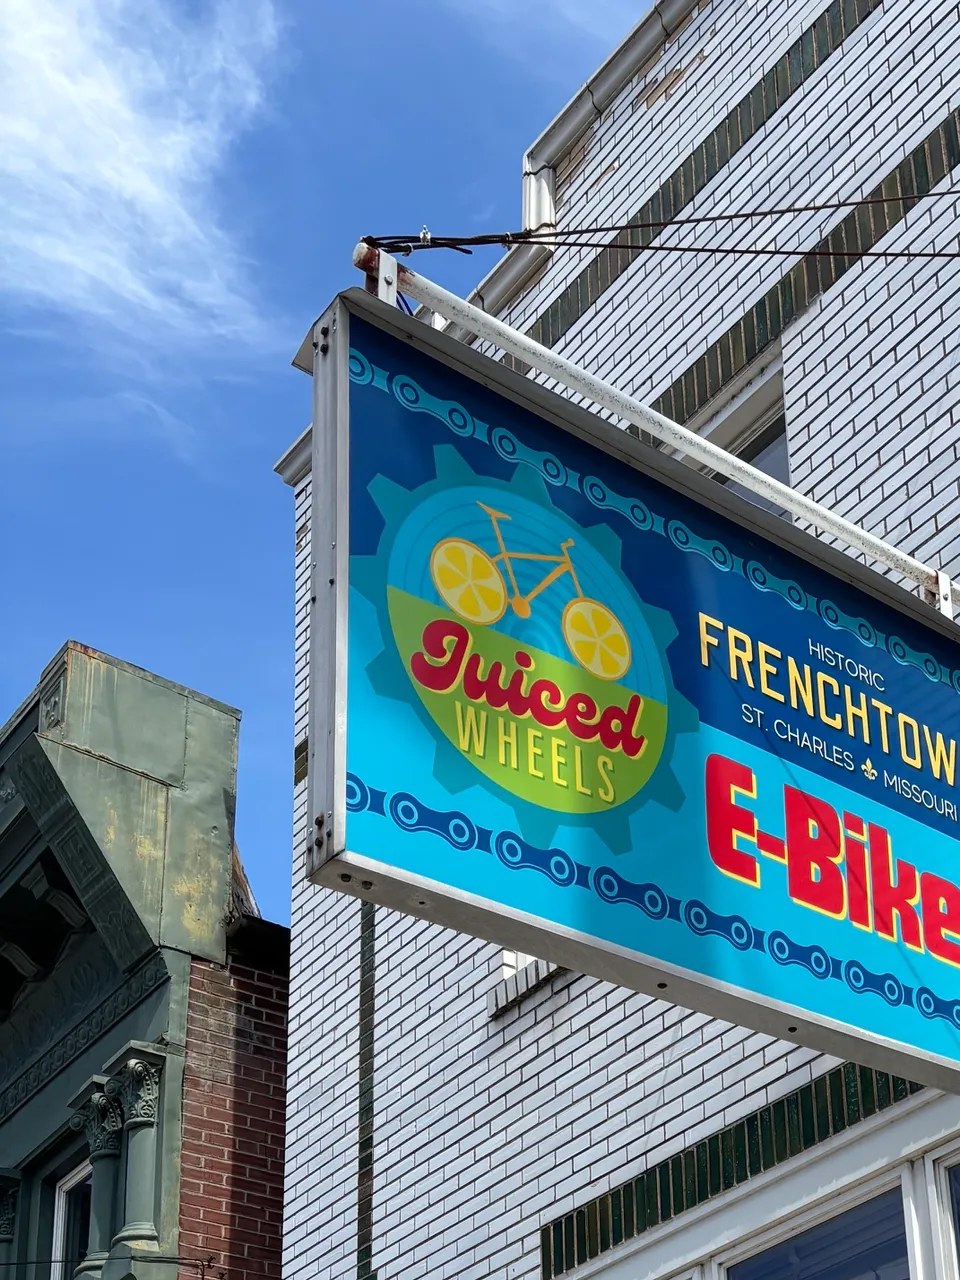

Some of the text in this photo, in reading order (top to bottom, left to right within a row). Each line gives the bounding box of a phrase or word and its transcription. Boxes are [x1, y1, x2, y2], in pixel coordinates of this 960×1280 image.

[410, 618, 648, 761] Juiced
[808, 638, 885, 692] HISTORIC
[455, 700, 616, 804] WHEELS
[741, 703, 958, 822] ST. CHARLES MISSOURI
